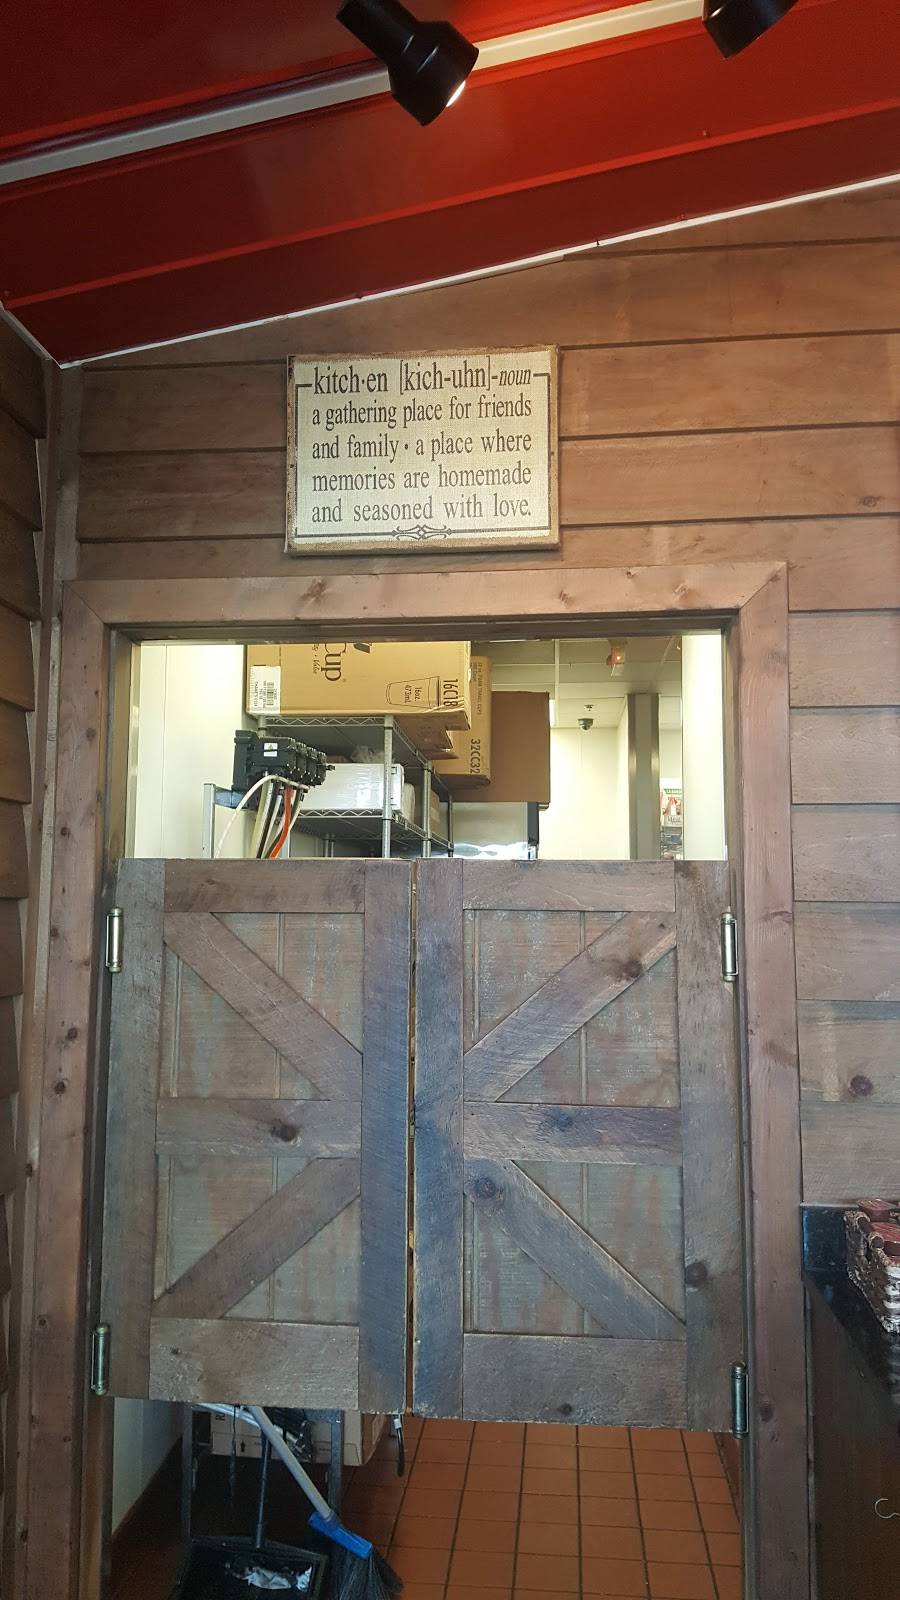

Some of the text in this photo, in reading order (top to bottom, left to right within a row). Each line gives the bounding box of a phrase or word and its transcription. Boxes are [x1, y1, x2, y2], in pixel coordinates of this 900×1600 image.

[312, 392, 532, 431] a gathering place for friends
[312, 427, 532, 464] and family a place where
[312, 460, 532, 492] memories are homemade
[312, 492, 531, 523] and seasoned with love.
[443, 678, 458, 707] 16C18
[470, 738, 481, 774] 32CC32
